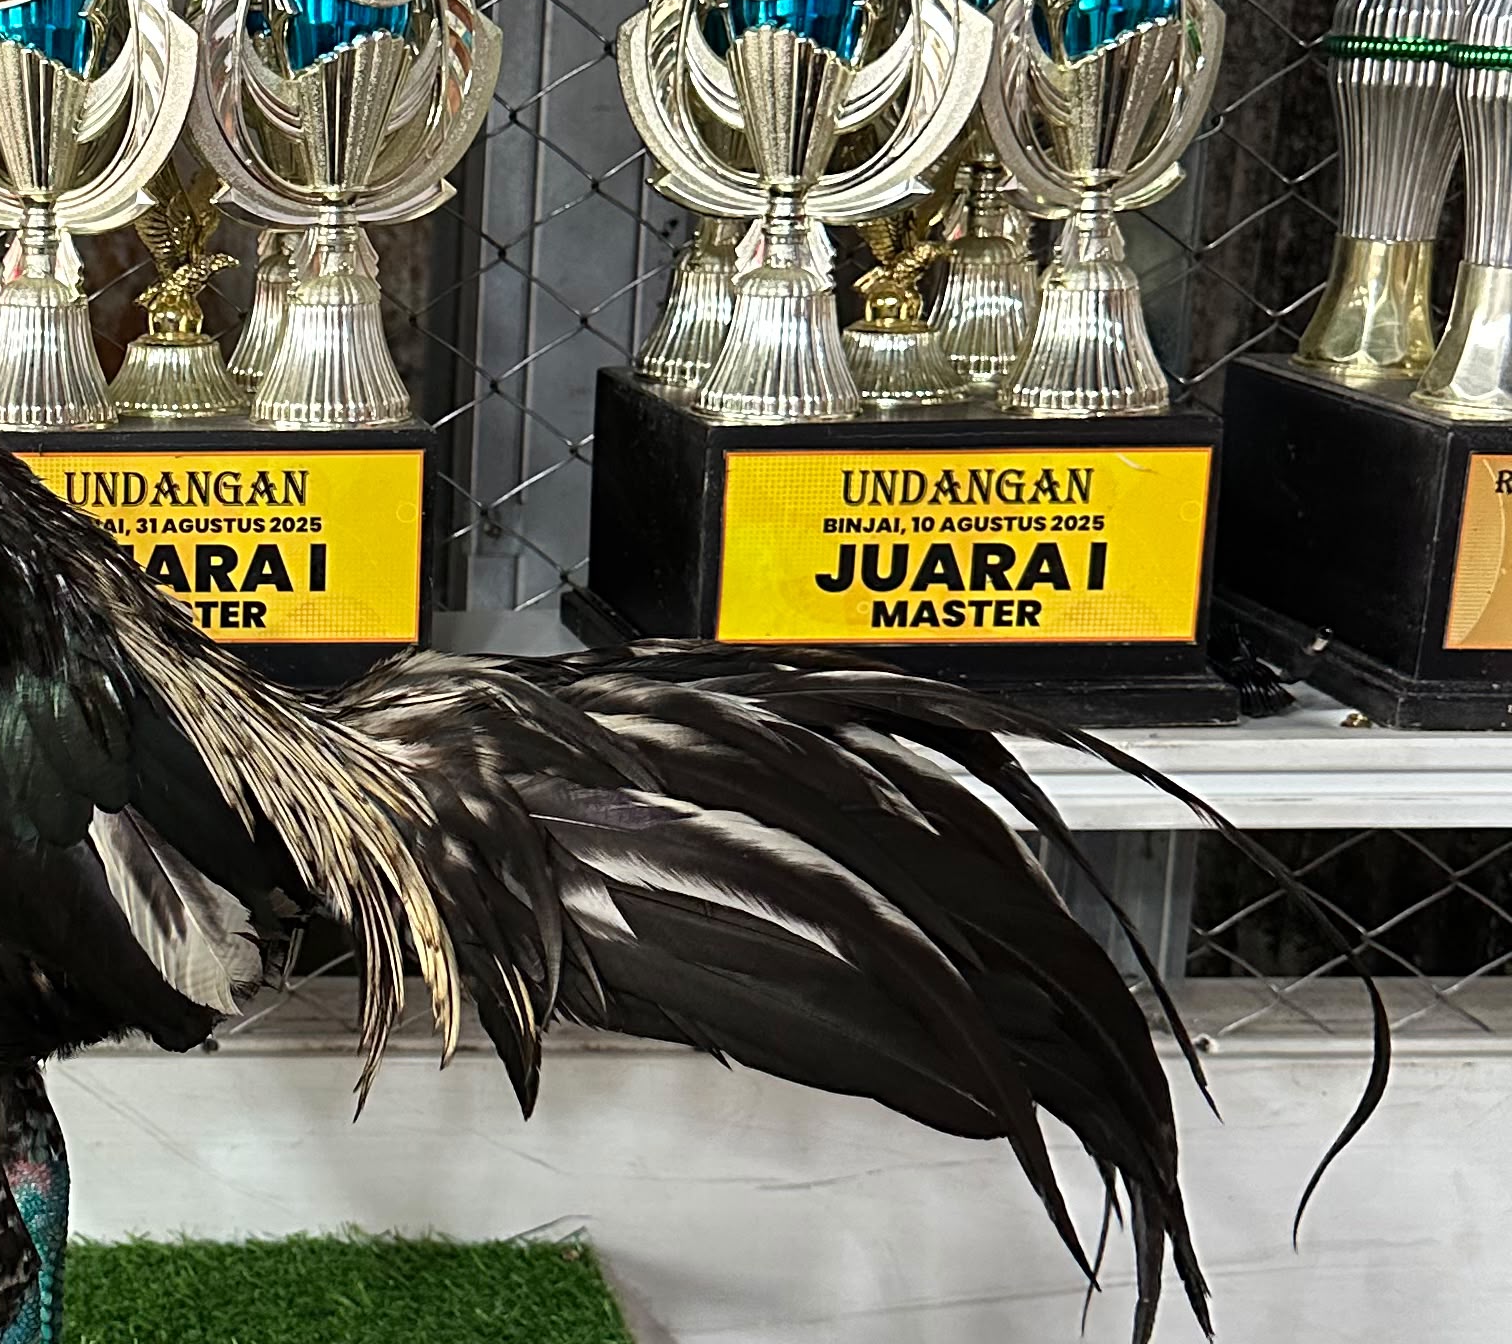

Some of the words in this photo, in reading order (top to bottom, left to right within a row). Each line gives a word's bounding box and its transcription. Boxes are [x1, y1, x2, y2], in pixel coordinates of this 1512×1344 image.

[64, 470, 309, 508] UNDANGAN
[841, 467, 1095, 506] UNDANGAN
[136, 517, 157, 533] 31
[162, 517, 265, 533] AGUSTUS
[269, 516, 322, 533] 2025
[823, 516, 906, 536] BINJAI,
[912, 516, 934, 533] 10
[939, 516, 1046, 533] AGUSTUS
[1051, 514, 1105, 532] 2025
[119, 543, 293, 593] ARA
[309, 543, 327, 592] I
[815, 542, 1070, 593] JUARA
[1087, 542, 1108, 591] I
[179, 600, 267, 629] TER
[872, 599, 1043, 628] MASTER
